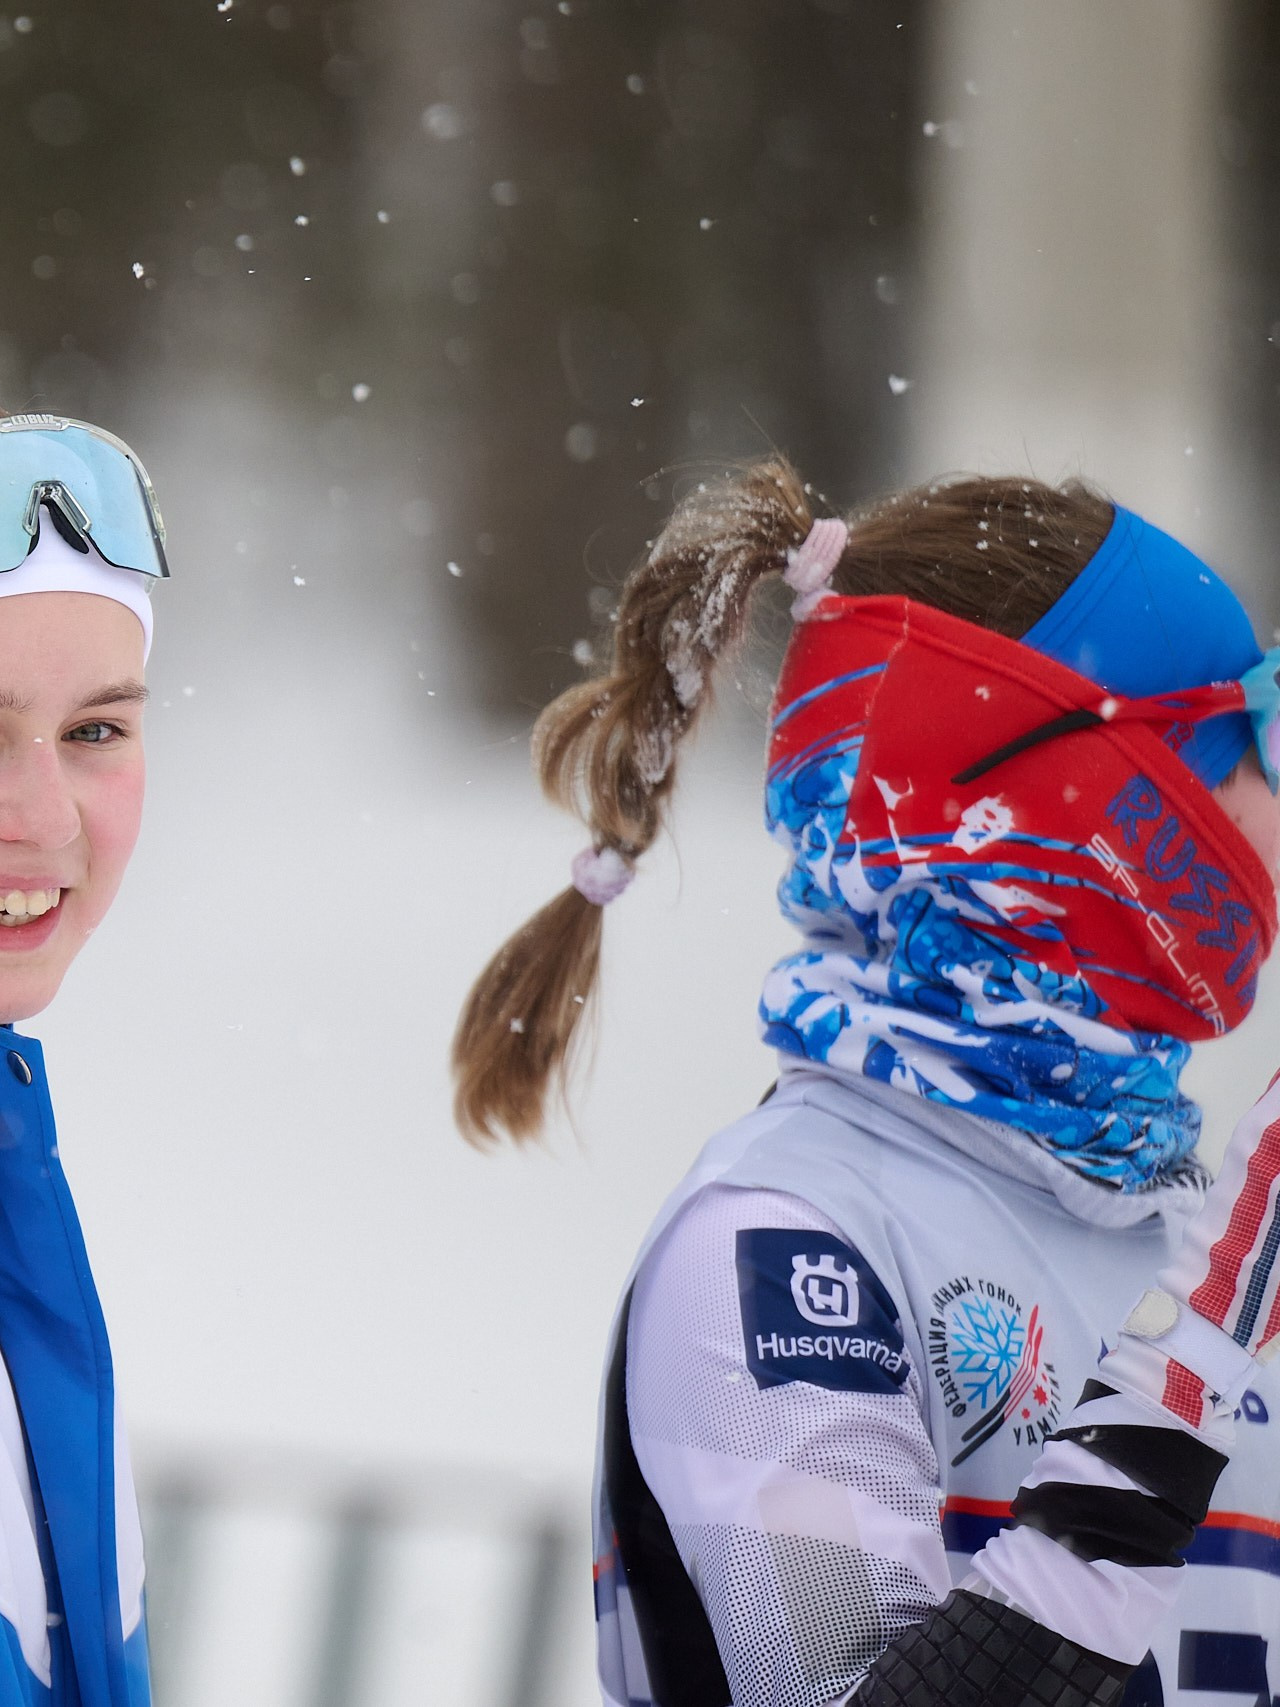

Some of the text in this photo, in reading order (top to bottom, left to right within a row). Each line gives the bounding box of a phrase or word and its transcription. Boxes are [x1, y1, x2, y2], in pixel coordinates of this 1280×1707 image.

[756, 1332, 902, 1373] Husqvarna
[928, 1317, 967, 1418] ФЕДЕРАЦИЯ
[978, 1279, 1022, 1317] ГОНОК
